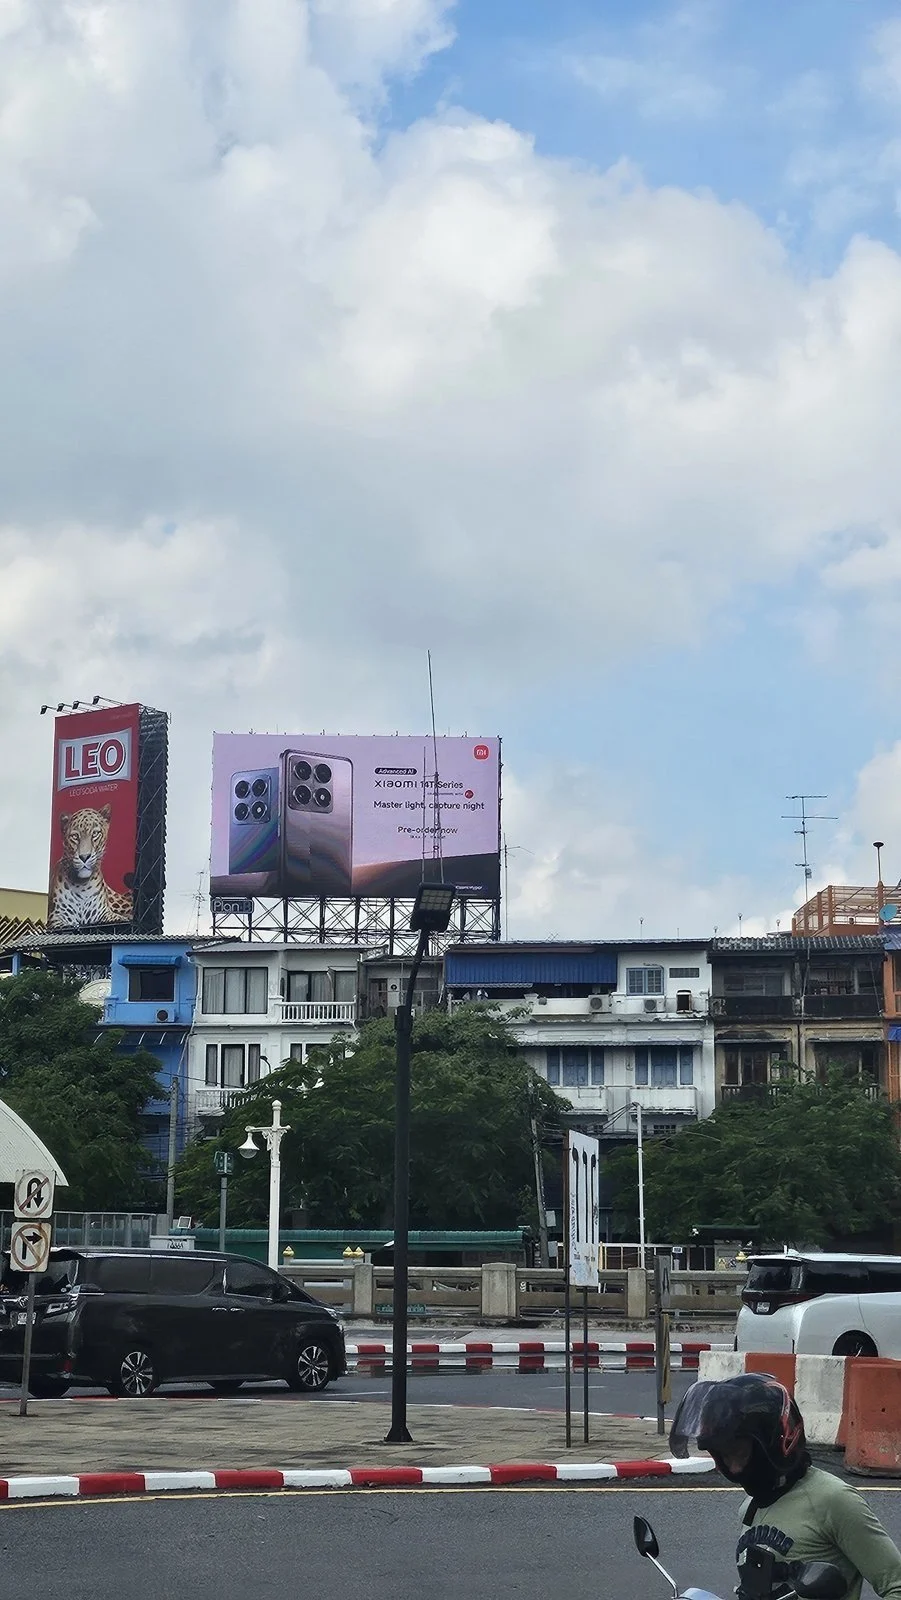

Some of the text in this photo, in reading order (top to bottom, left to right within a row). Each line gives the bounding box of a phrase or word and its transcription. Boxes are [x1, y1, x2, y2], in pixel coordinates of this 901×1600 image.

[65, 739, 126, 781] LEO
[420, 781, 436, 789] 14T
[438, 781, 464, 789] Series
[69, 788, 81, 797] LEO
[82, 785, 99, 795] SODA
[373, 801, 402, 809] Master
[429, 802, 460, 810] capture
[463, 802, 485, 812] night
[397, 826, 439, 834] Pre-order
[214, 901, 240, 911] Plan
